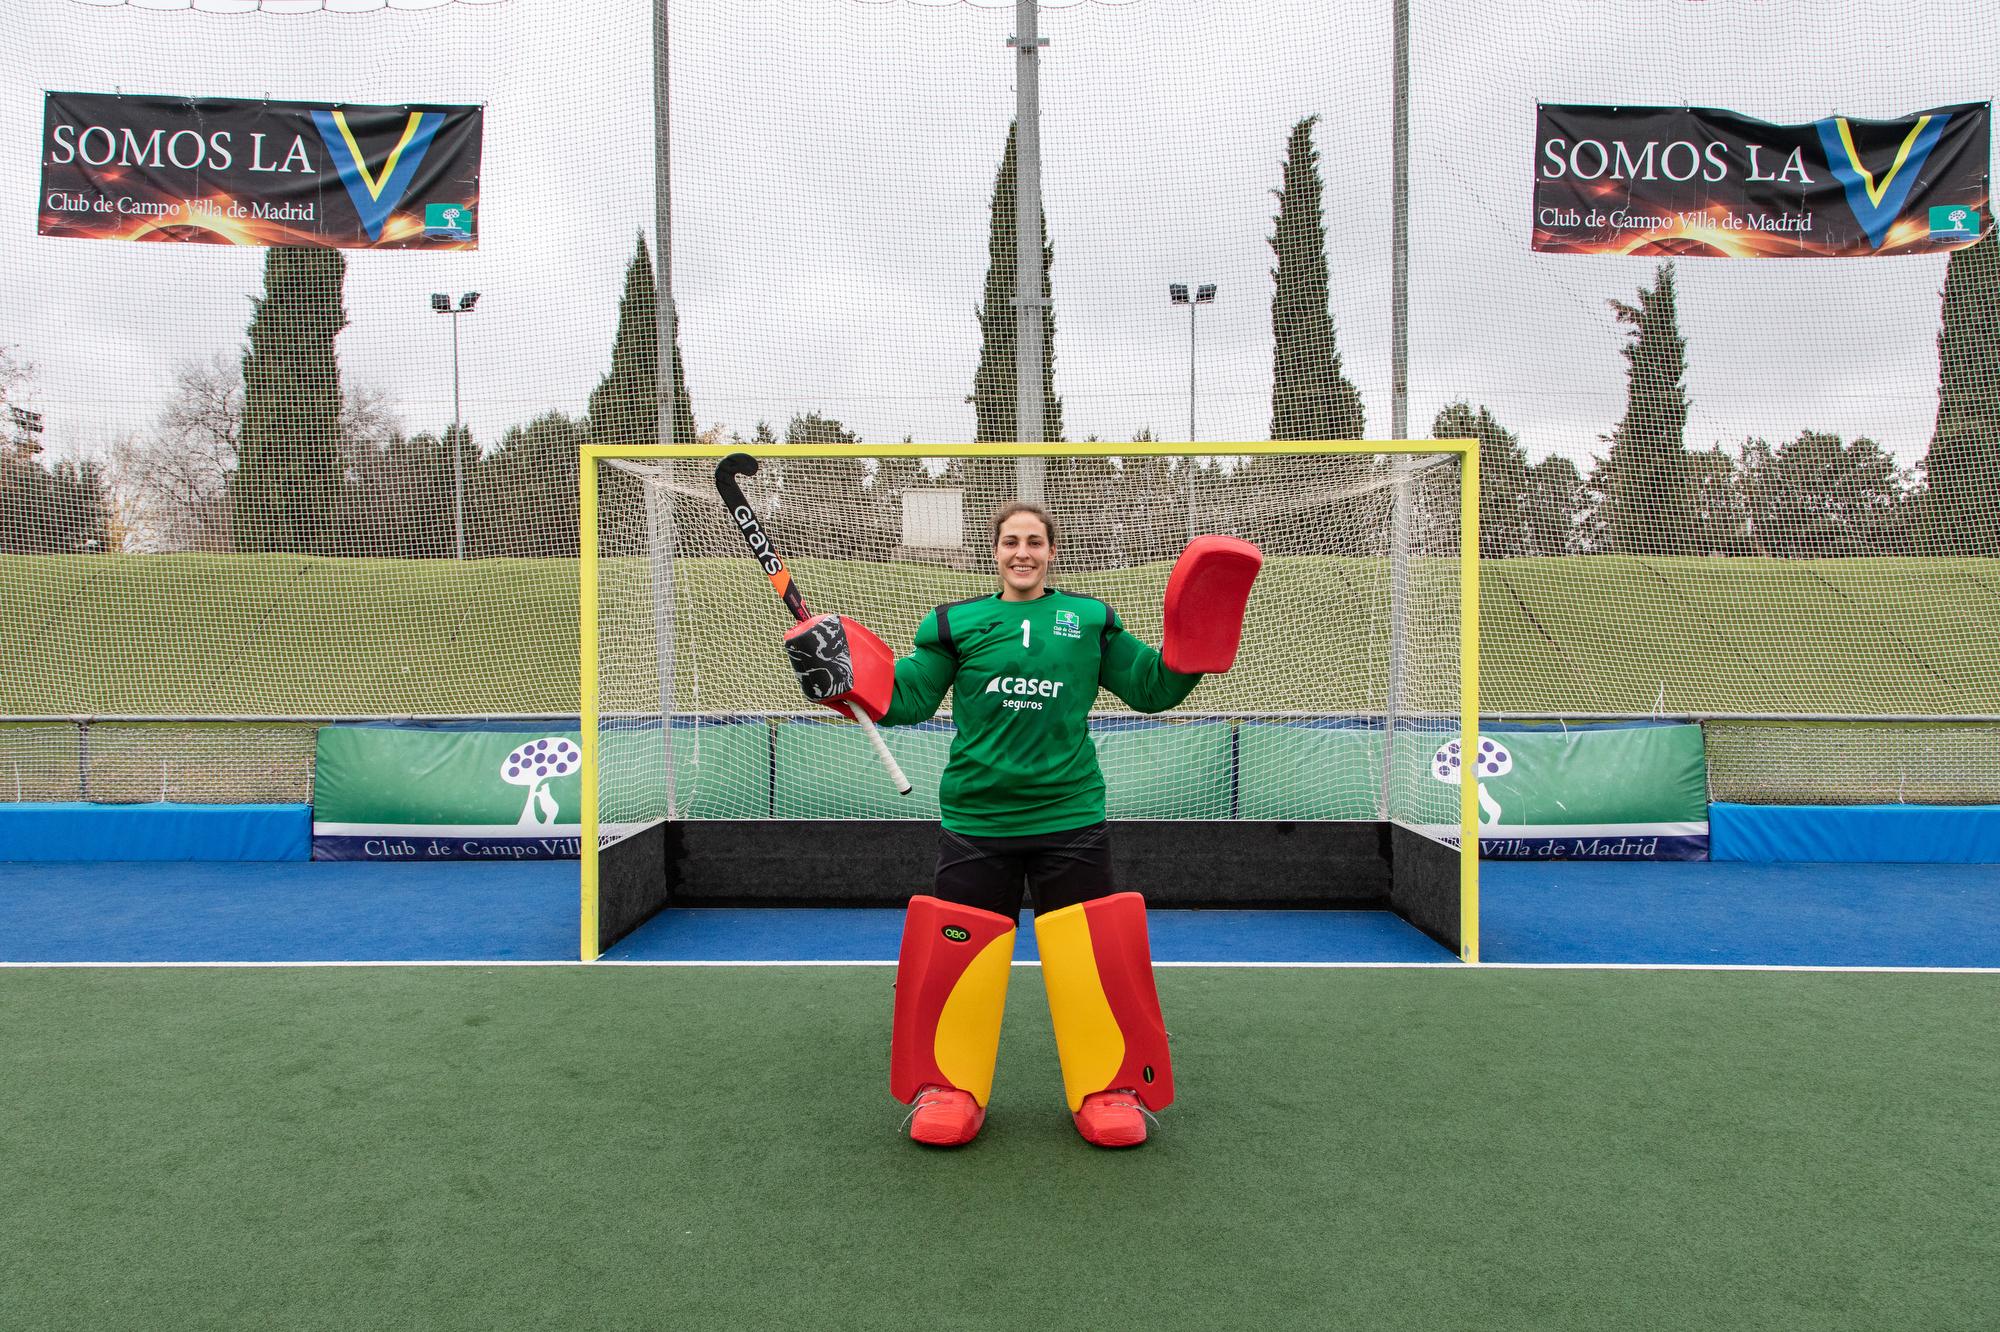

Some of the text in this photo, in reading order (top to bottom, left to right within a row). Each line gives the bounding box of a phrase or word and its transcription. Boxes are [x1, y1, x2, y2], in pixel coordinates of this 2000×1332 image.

[51, 110, 448, 242] SOMOS LA V
[1542, 113, 1953, 249] SOMOS LA V
[48, 192, 315, 221] Club de Campo Villa de Madrid
[1540, 208, 1813, 234] Club de Campo Villa de Madrid
[1020, 619, 1031, 649] 1
[1001, 677, 1064, 698] caser
[1002, 699, 1043, 711] seguros
[364, 838, 582, 859] Club de Campo Vill
[1479, 837, 1659, 856] Villa de Madrid
[945, 928, 967, 940] OBO
